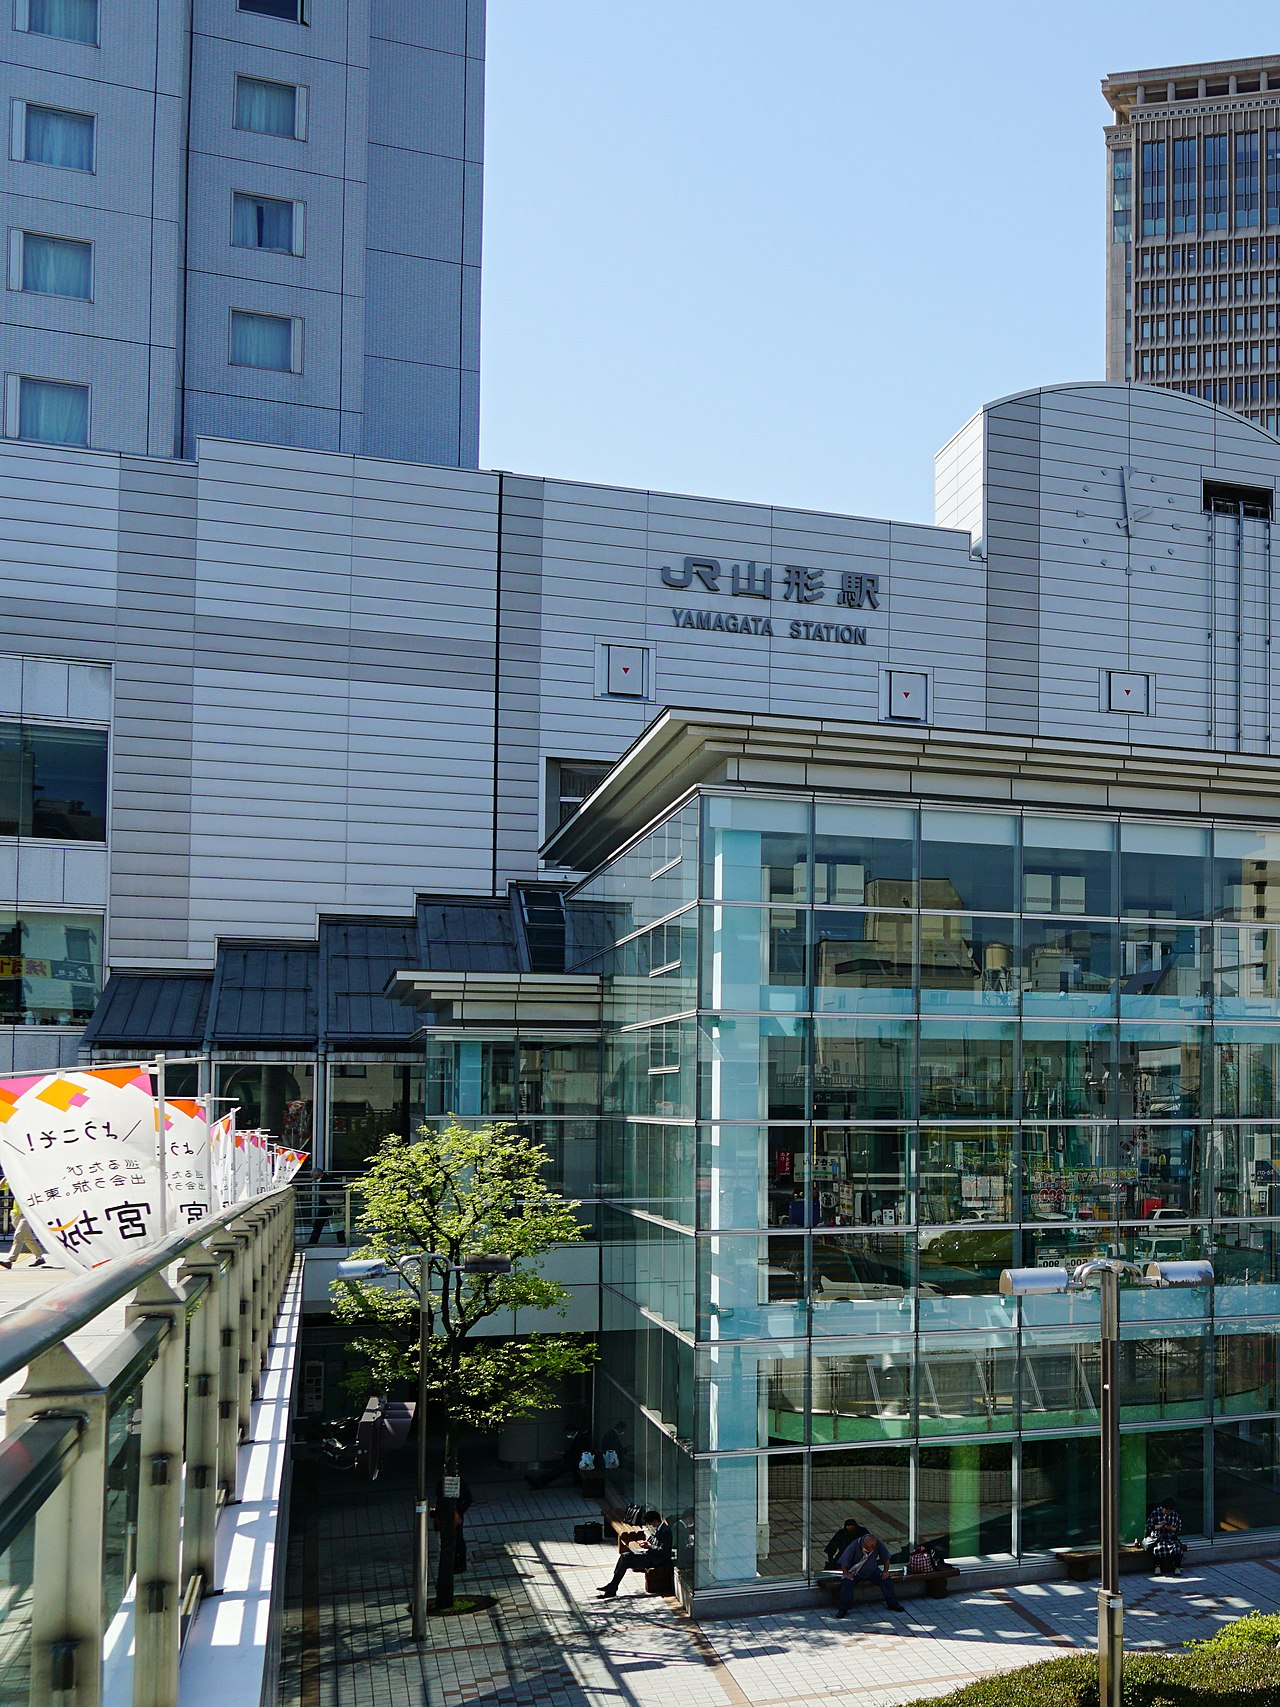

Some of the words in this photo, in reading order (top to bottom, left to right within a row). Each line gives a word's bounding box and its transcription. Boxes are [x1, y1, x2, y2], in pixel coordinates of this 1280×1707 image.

[662, 556, 880, 609] JR山形駅
[672, 608, 774, 637] YAMAGATA
[789, 619, 867, 645] STATION
